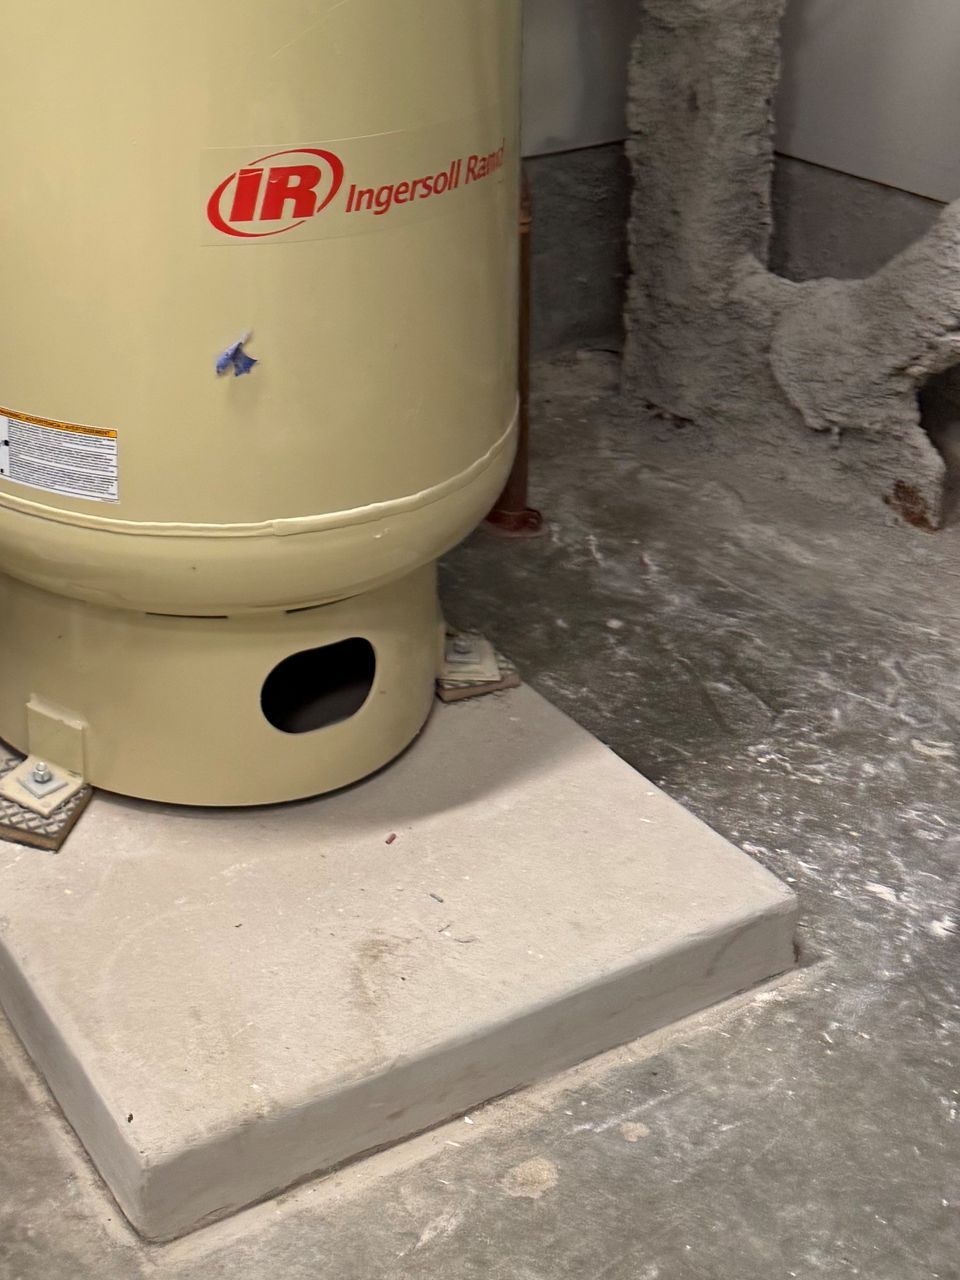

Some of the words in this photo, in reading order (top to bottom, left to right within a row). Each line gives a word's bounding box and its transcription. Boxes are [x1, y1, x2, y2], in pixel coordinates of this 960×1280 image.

[229, 164, 322, 222] IR
[345, 159, 462, 216] Ingersoll
[464, 137, 506, 185] Rand
